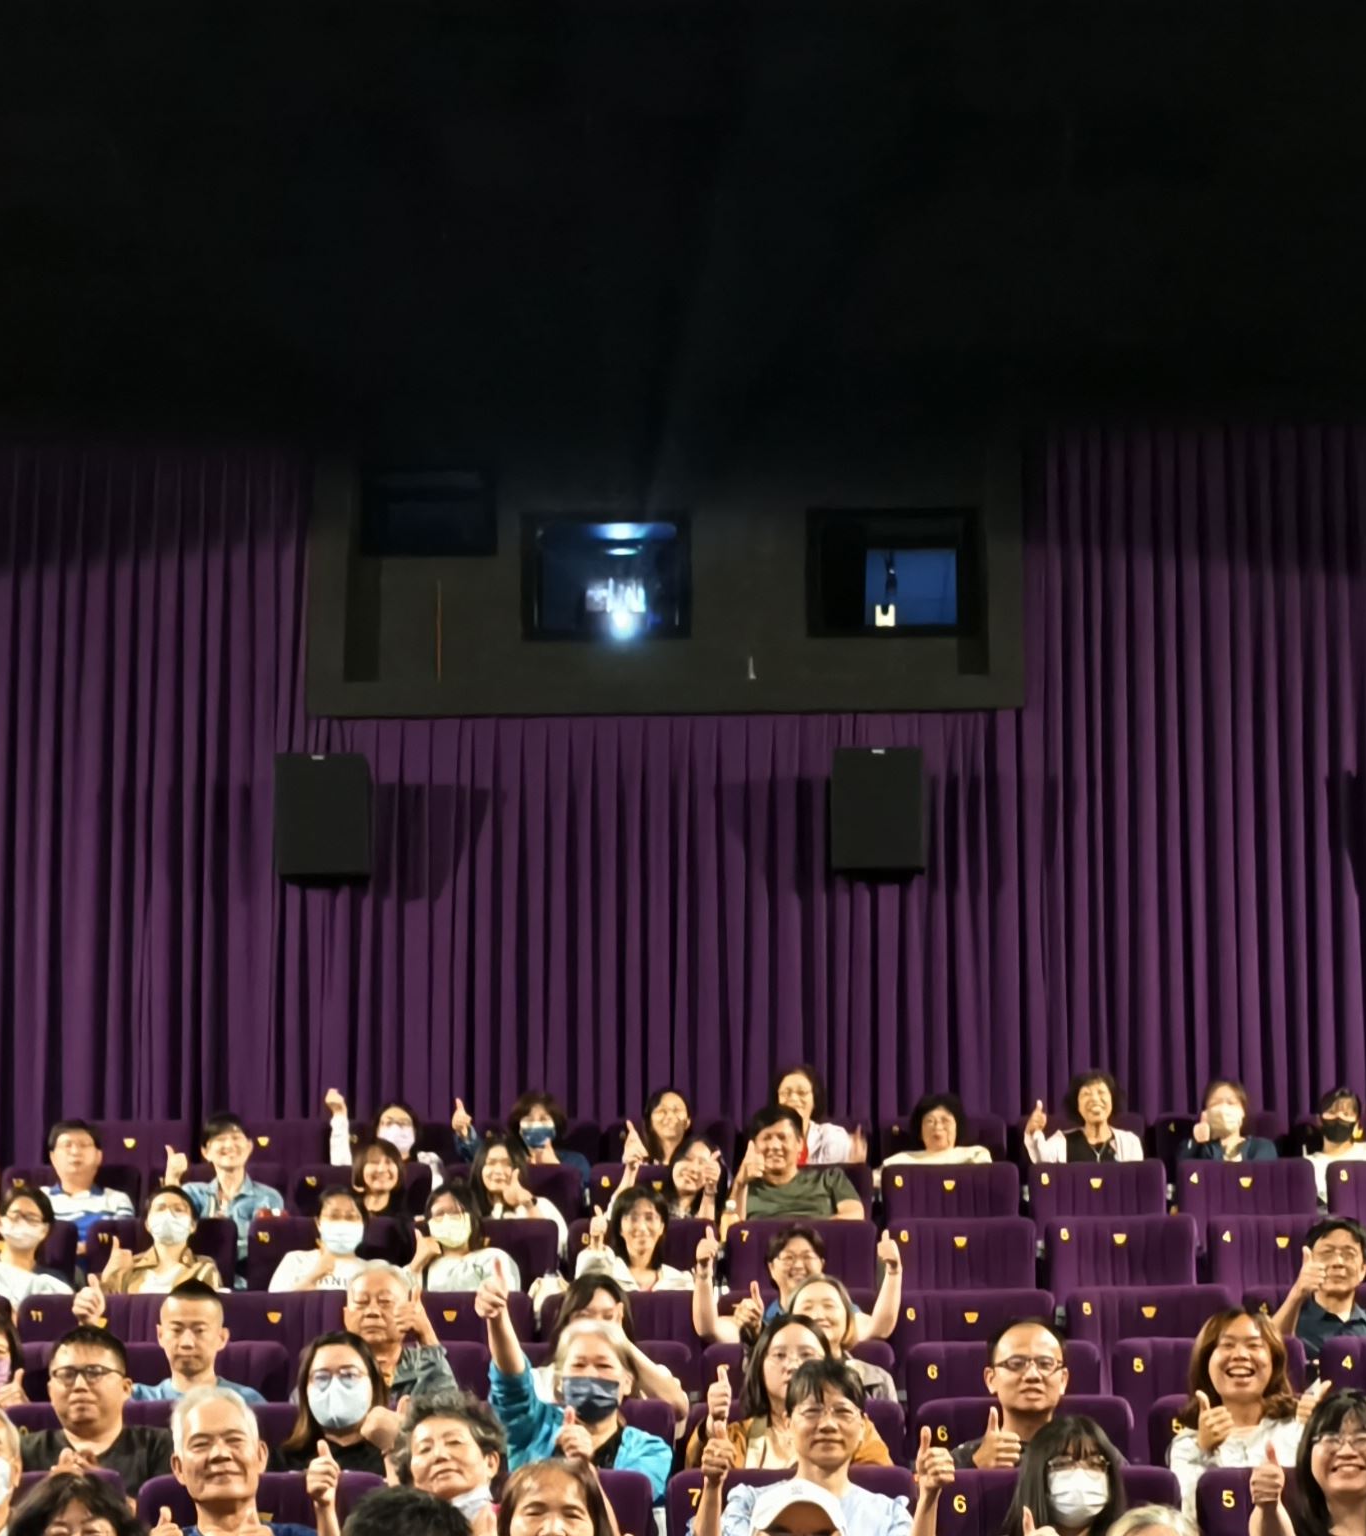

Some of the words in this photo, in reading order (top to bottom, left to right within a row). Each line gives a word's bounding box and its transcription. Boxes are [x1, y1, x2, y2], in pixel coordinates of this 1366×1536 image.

[1133, 1357, 1144, 1373] 5
[1342, 1355, 1353, 1370] 4
[927, 1364, 938, 1380] 6
[936, 1426, 948, 1442] 6
[688, 1489, 701, 1508] 7
[953, 1494, 967, 1513] 6
[1222, 1490, 1235, 1508] 5
